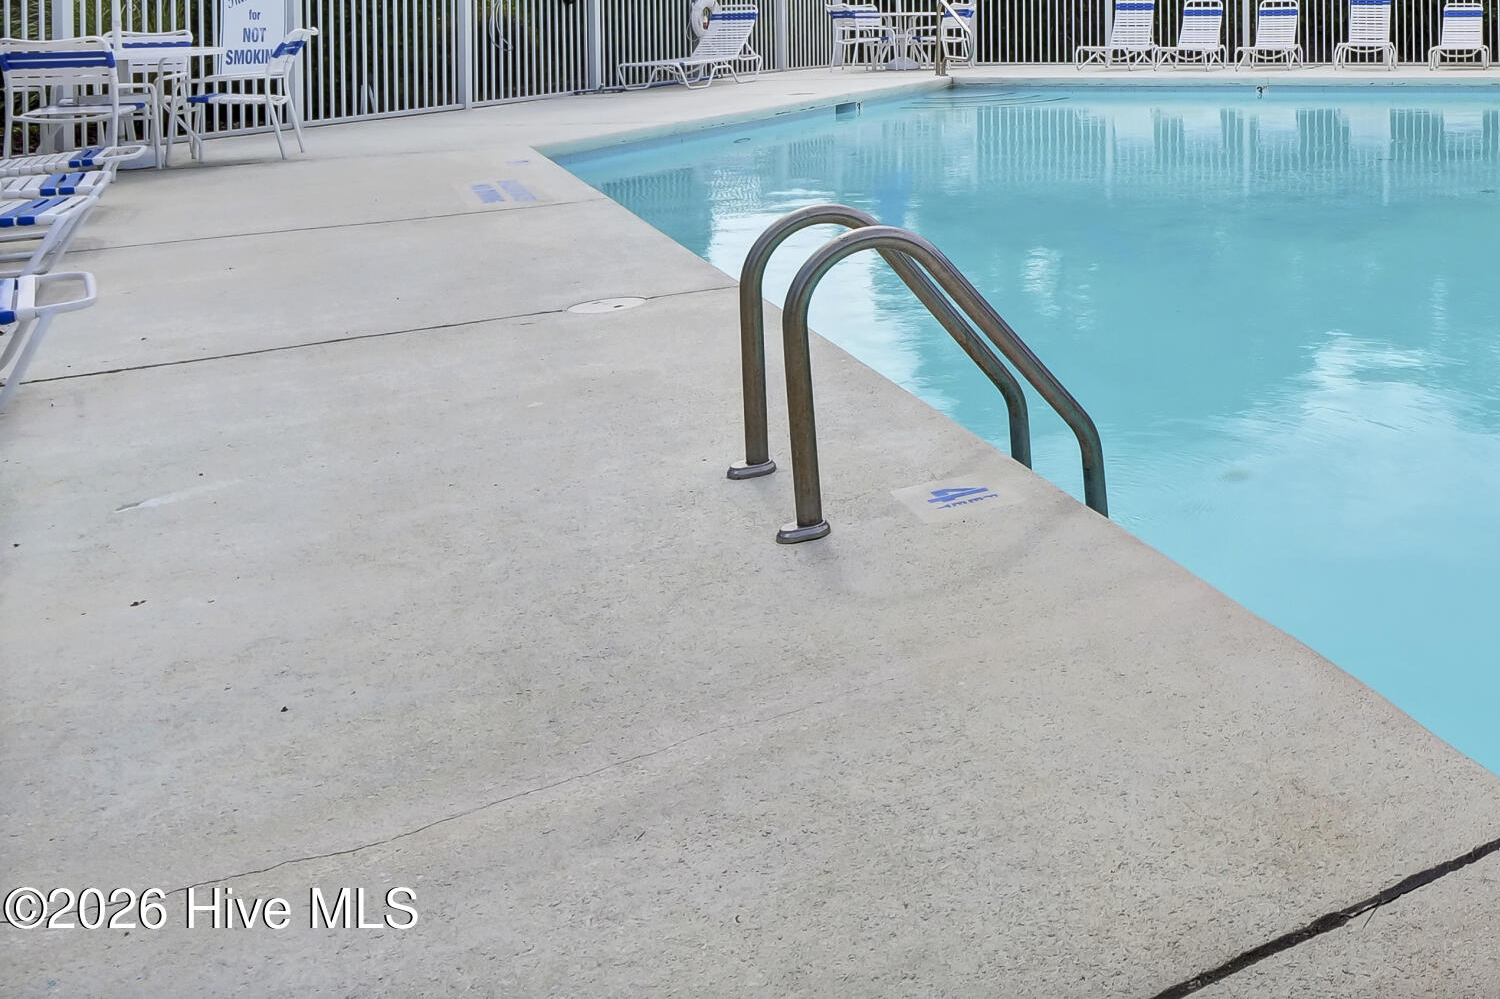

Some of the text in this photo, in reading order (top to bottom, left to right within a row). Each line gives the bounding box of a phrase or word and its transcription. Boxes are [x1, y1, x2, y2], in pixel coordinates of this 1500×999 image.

[248, 9, 261, 20] for
[243, 27, 267, 42] NOT
[225, 49, 273, 65] SMOKIN
